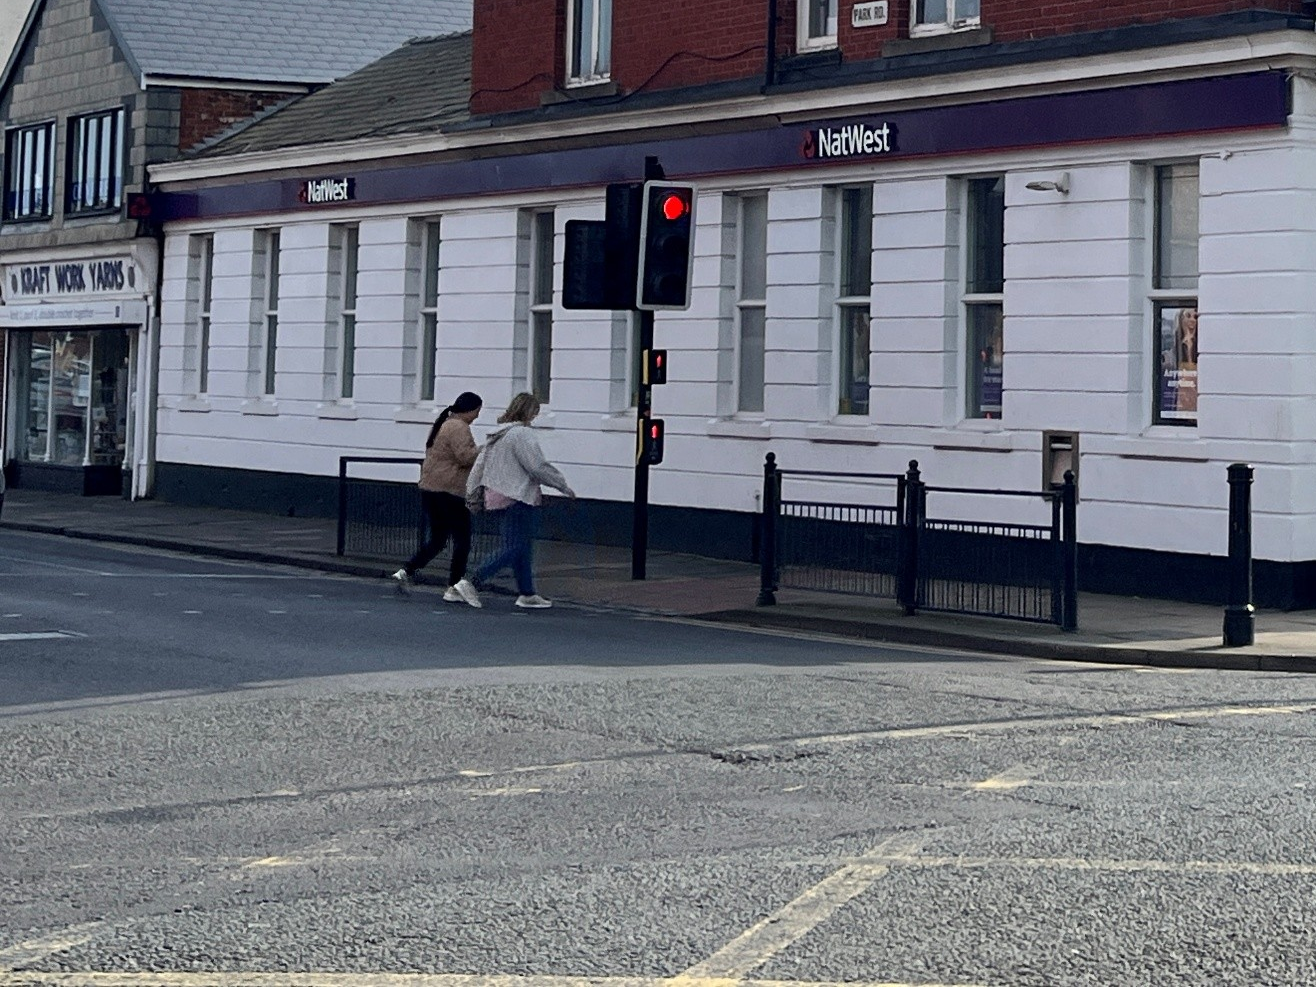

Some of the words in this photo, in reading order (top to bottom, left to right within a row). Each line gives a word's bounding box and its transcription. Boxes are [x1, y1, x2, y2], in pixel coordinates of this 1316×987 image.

[854, 7, 871, 22] PARK
[818, 122, 890, 157] NatWest
[307, 177, 348, 203] NatWest
[20, 266, 50, 295] KRAFT
[55, 263, 86, 293] WORK
[89, 260, 124, 291] YARNS
